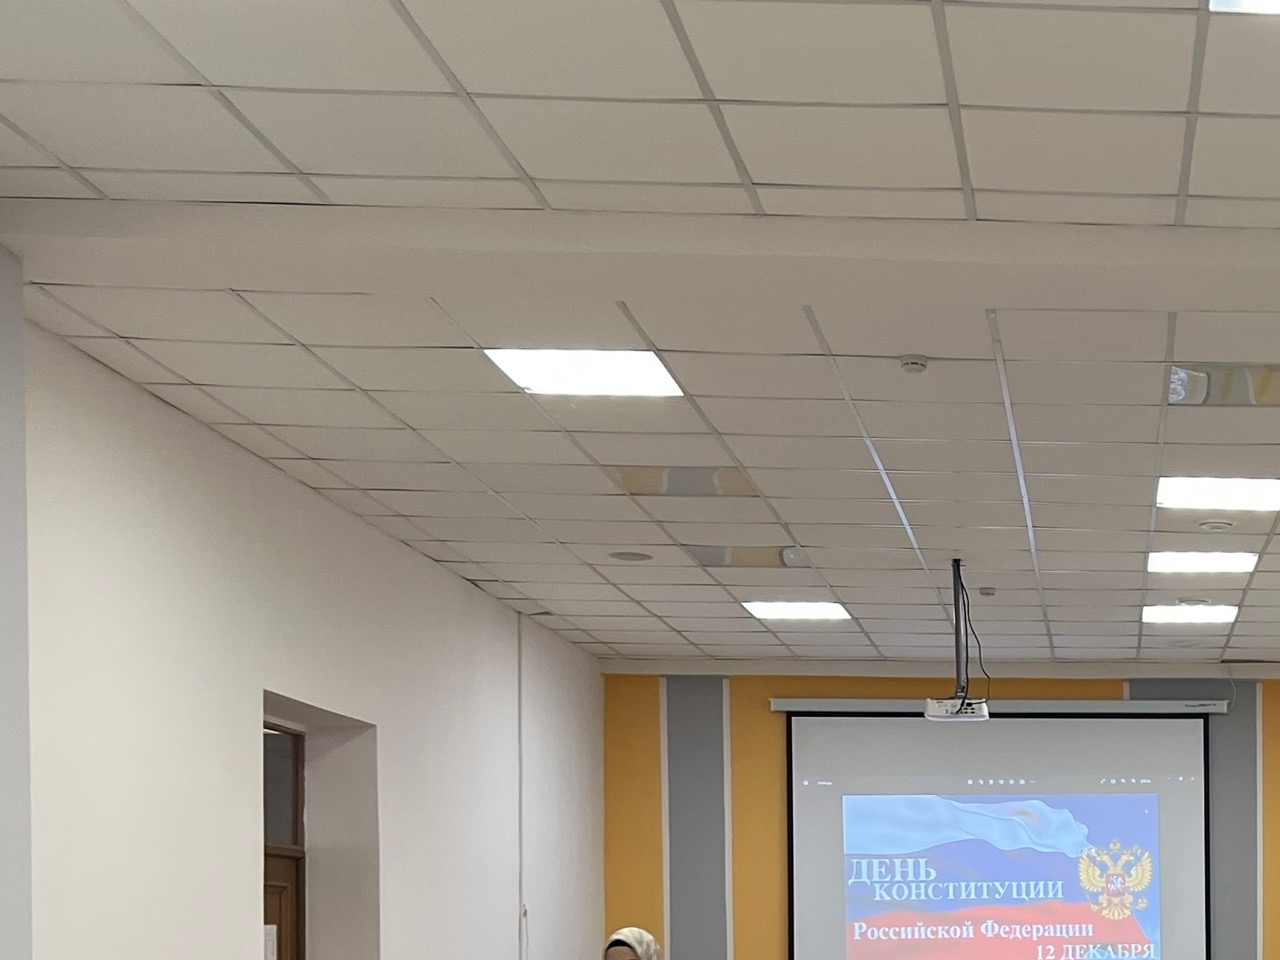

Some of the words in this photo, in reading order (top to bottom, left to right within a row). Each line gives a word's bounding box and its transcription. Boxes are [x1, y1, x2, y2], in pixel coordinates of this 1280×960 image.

[848, 857, 937, 886] ДЕНЬ
[873, 880, 1064, 902] КОНСТИТУЦИИ
[853, 920, 975, 941] Российской
[980, 919, 1094, 941] Федерации
[1036, 945, 1056, 960] 12
